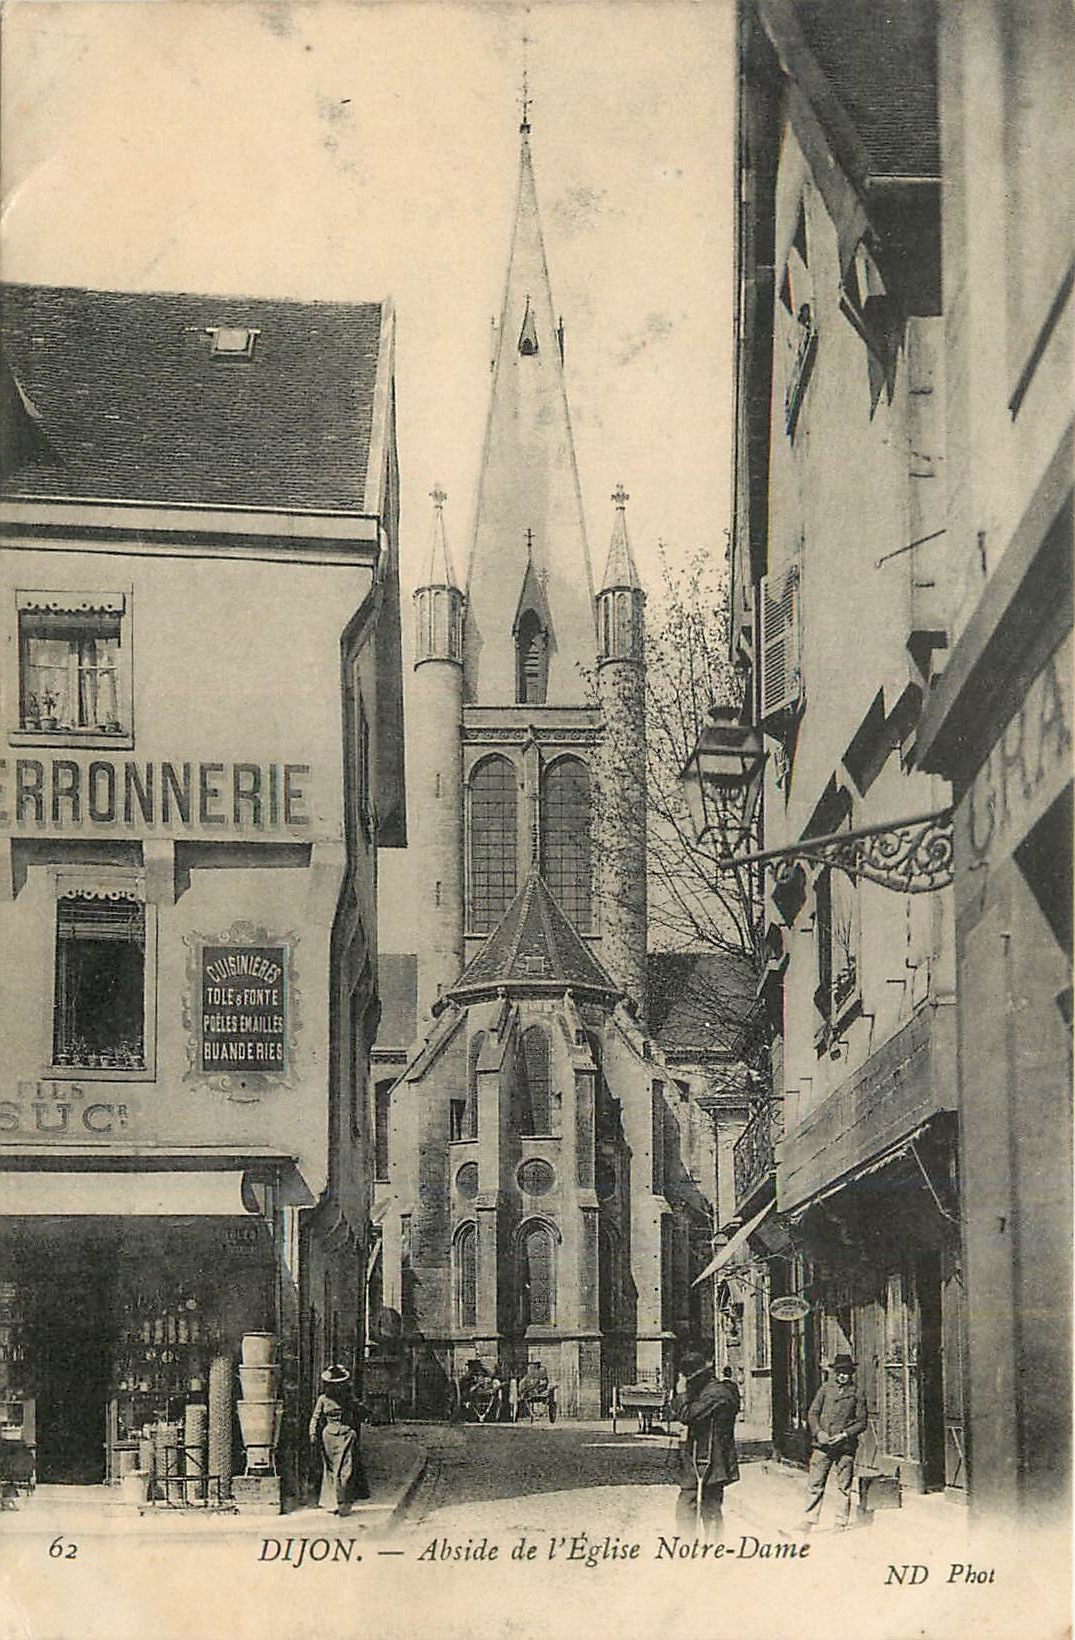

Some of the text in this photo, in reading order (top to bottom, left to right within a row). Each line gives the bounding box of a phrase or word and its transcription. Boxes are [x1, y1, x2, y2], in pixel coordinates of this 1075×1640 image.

[0, 759, 310, 825] RRONNERIE
[244, 988, 278, 1006] FONTE
[204, 1042, 283, 1060] BUANDERIES
